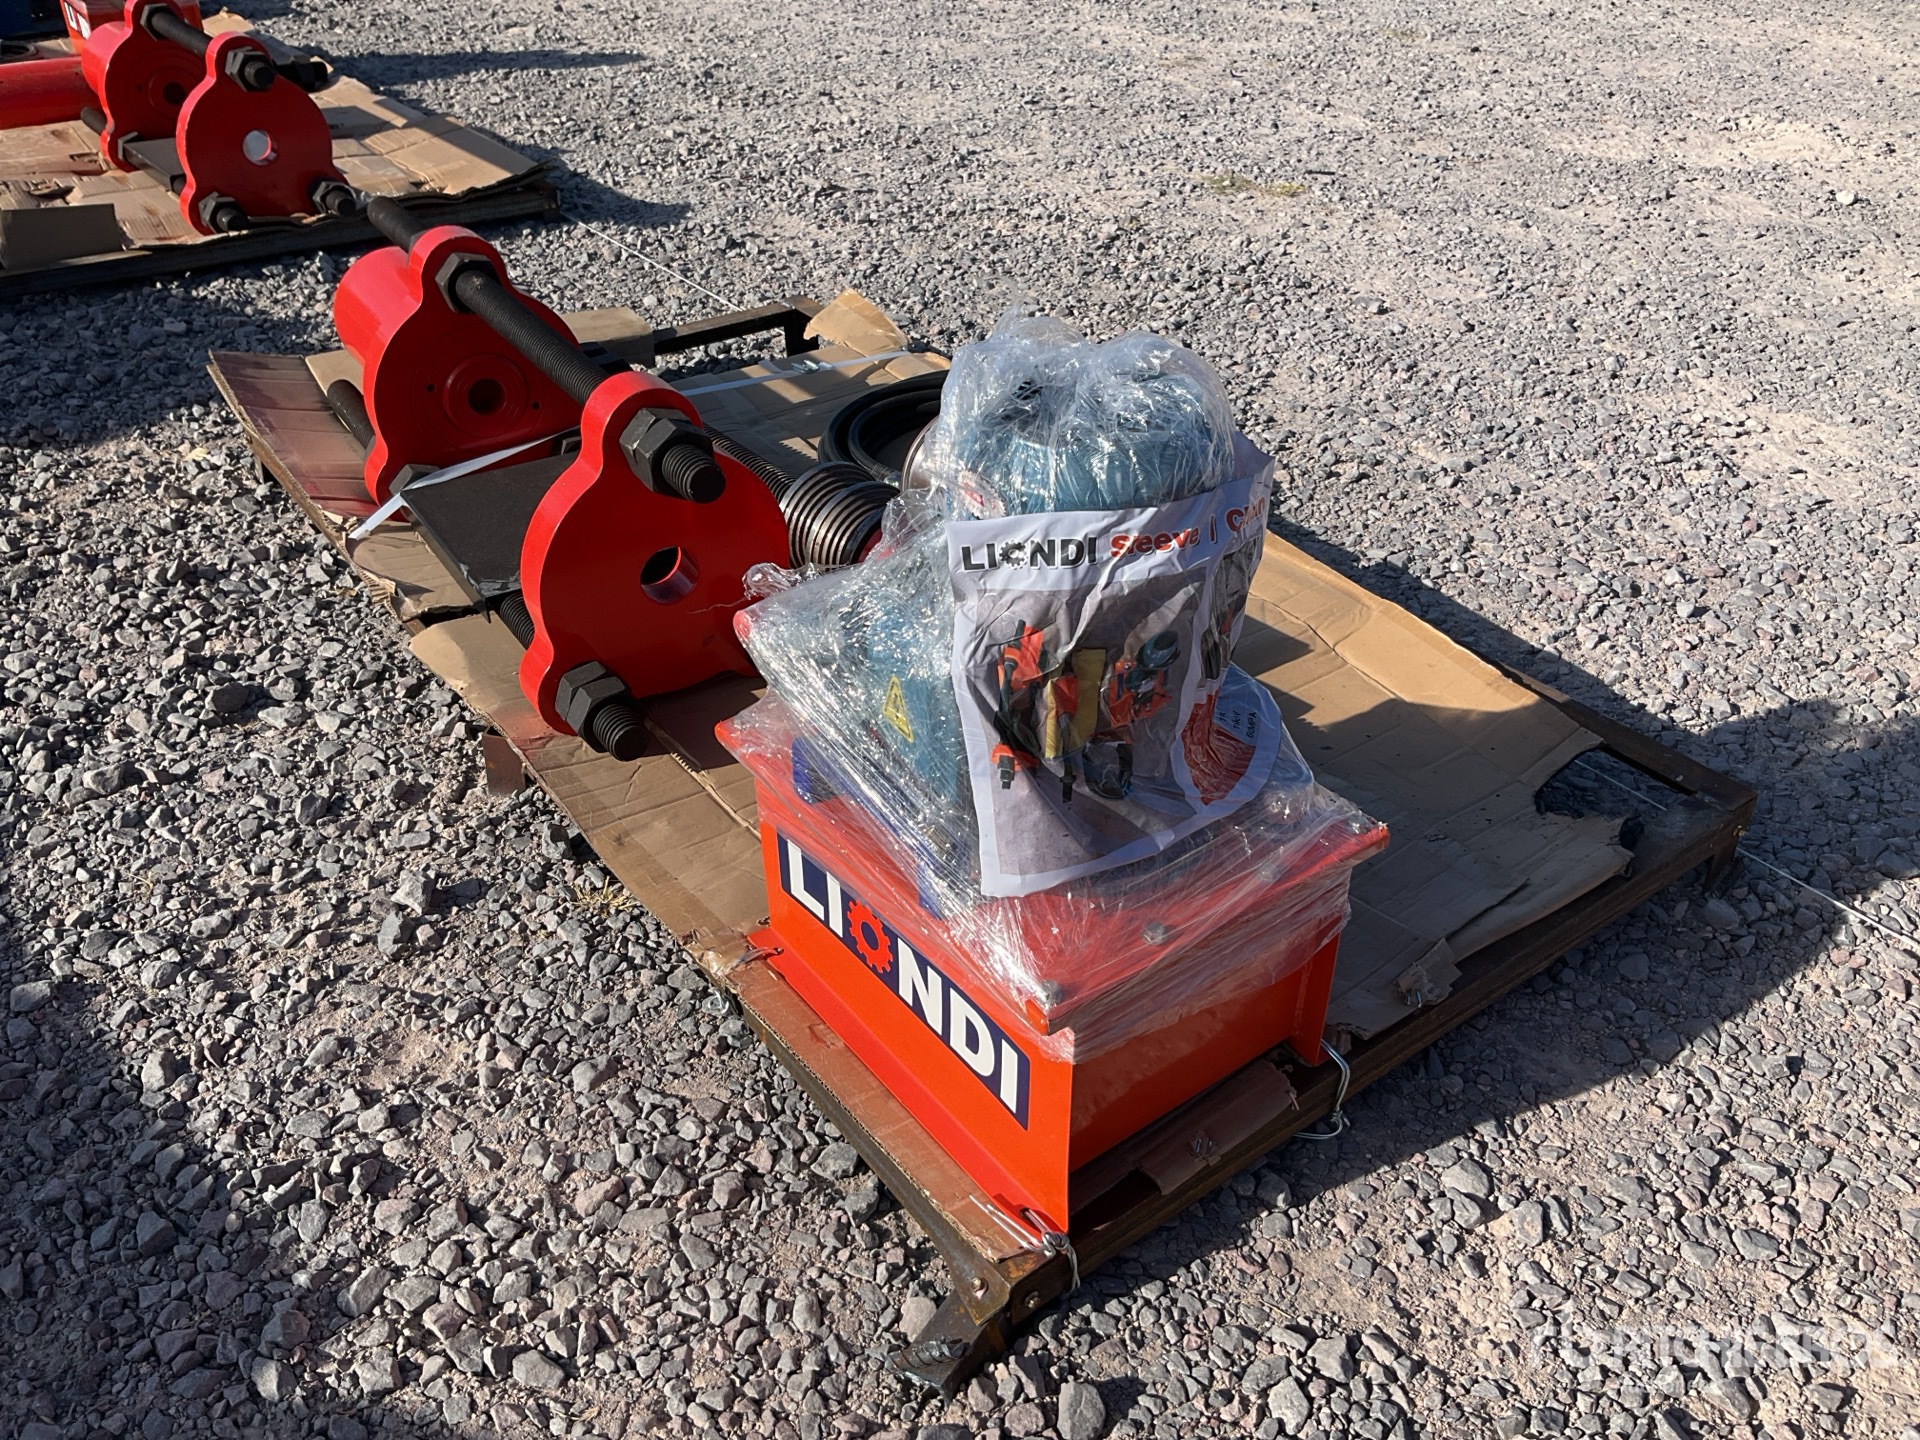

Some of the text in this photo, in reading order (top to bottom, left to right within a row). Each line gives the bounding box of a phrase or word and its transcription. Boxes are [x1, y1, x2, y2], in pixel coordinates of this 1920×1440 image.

[961, 536, 1098, 571] LIONDI
[1110, 527, 1200, 559] Sleeve
[787, 839, 1019, 1114] LIONDI
